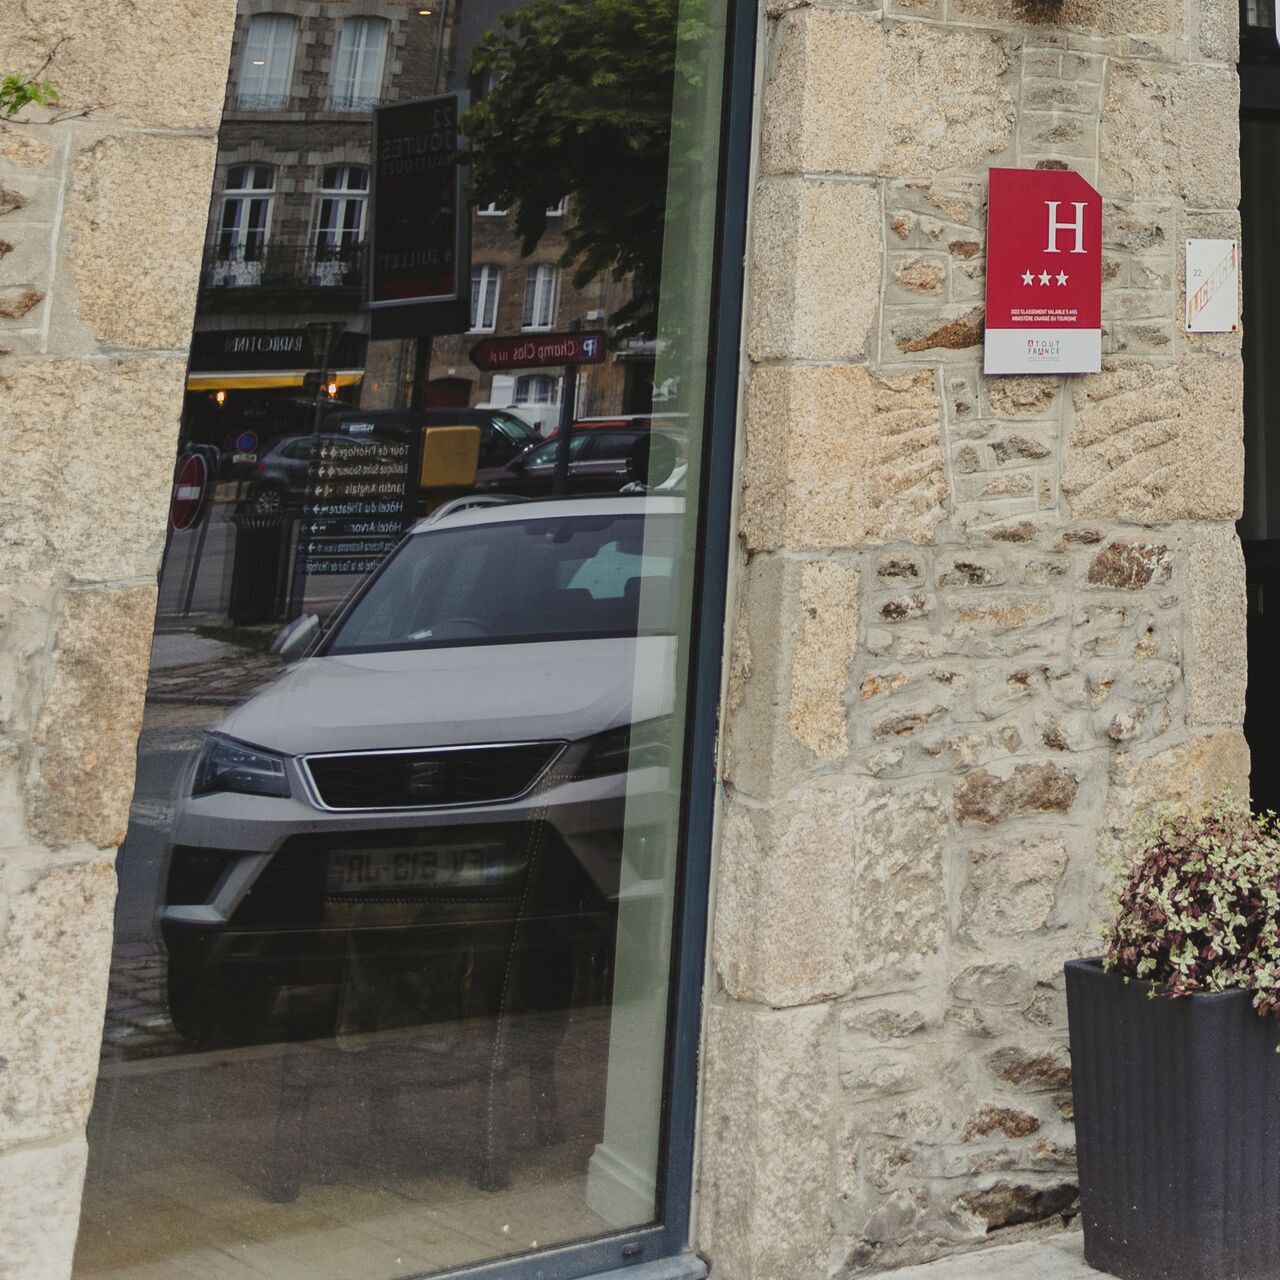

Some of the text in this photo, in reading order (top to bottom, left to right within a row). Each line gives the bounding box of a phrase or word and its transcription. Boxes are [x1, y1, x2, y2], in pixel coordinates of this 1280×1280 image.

[1043, 201, 1088, 254] H
[1028, 339, 1060, 347] ATOUT
[1028, 347, 1060, 355] FRANCE
